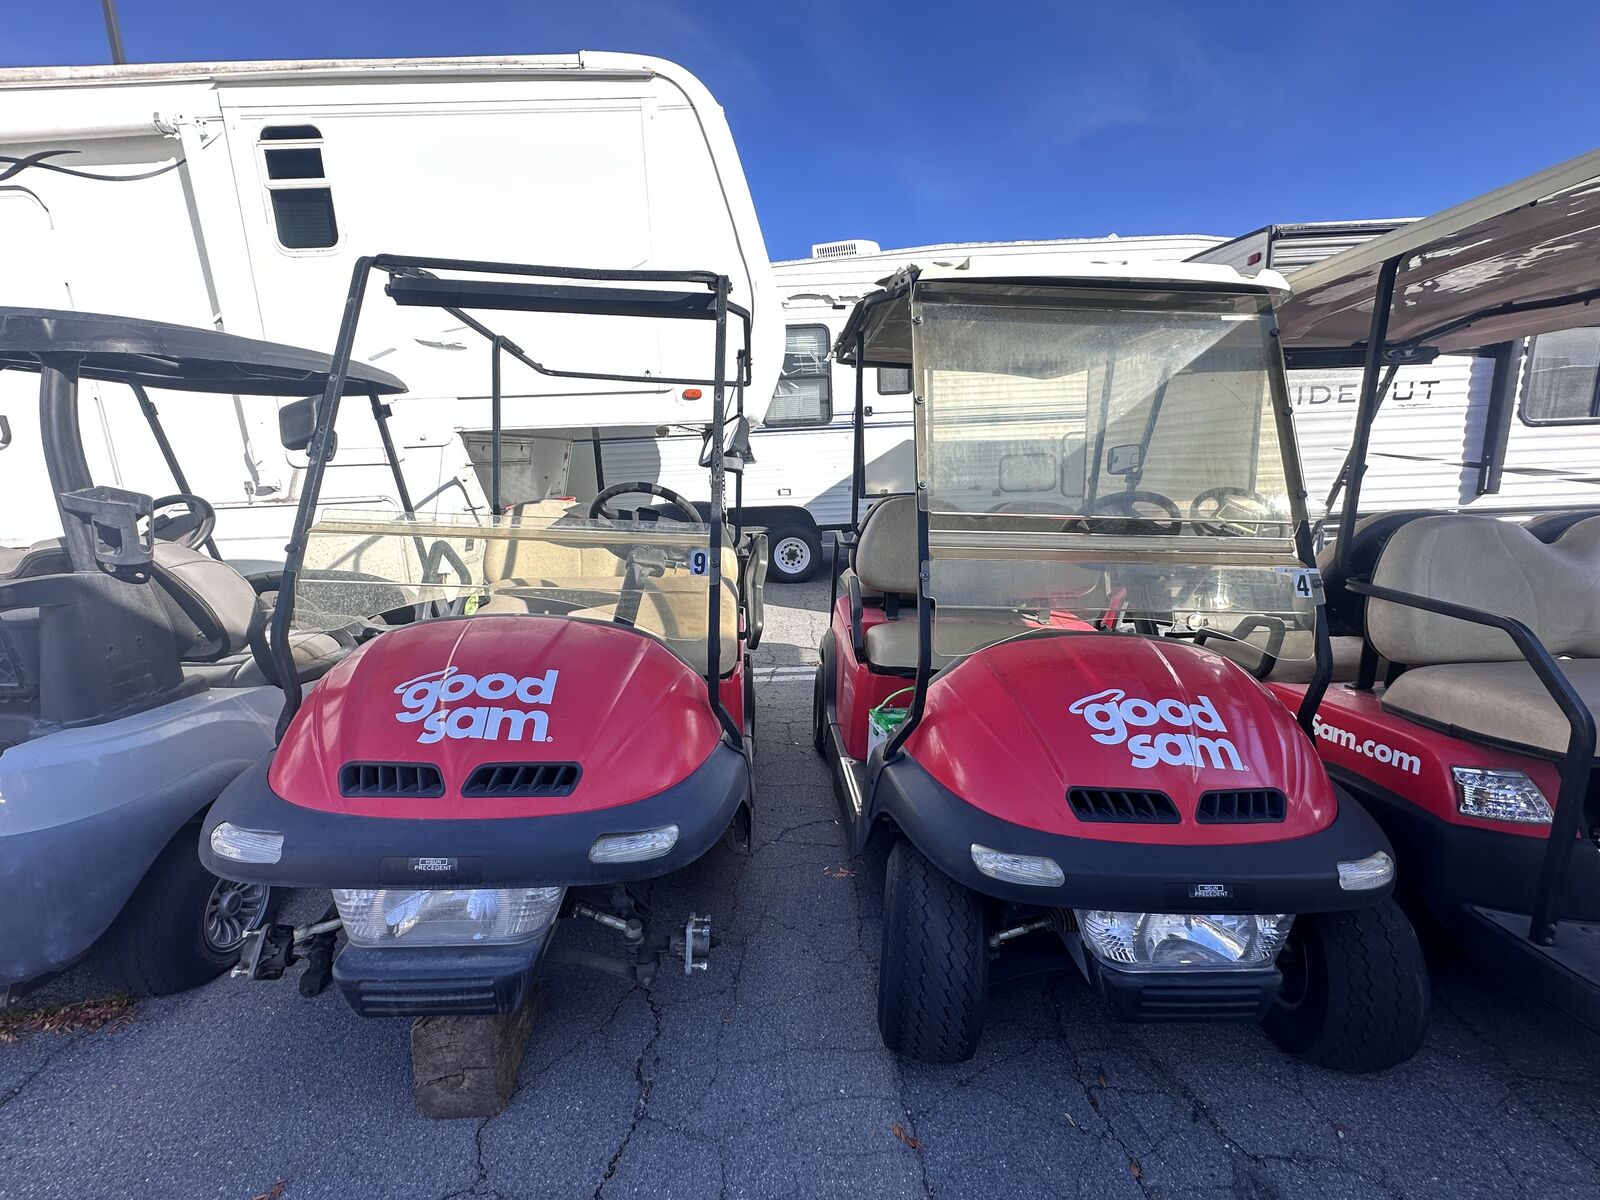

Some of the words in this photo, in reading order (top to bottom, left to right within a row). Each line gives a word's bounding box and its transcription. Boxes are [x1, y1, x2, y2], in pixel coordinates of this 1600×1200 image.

[1268, 380, 1440, 407] IDEUT
[693, 552, 706, 575] 9
[1296, 574, 1310, 597] 4
[394, 666, 559, 723] good
[416, 706, 550, 744] sam
[1068, 688, 1228, 745] good
[1127, 732, 1245, 770] sam
[1290, 711, 1421, 775] Sam.com
